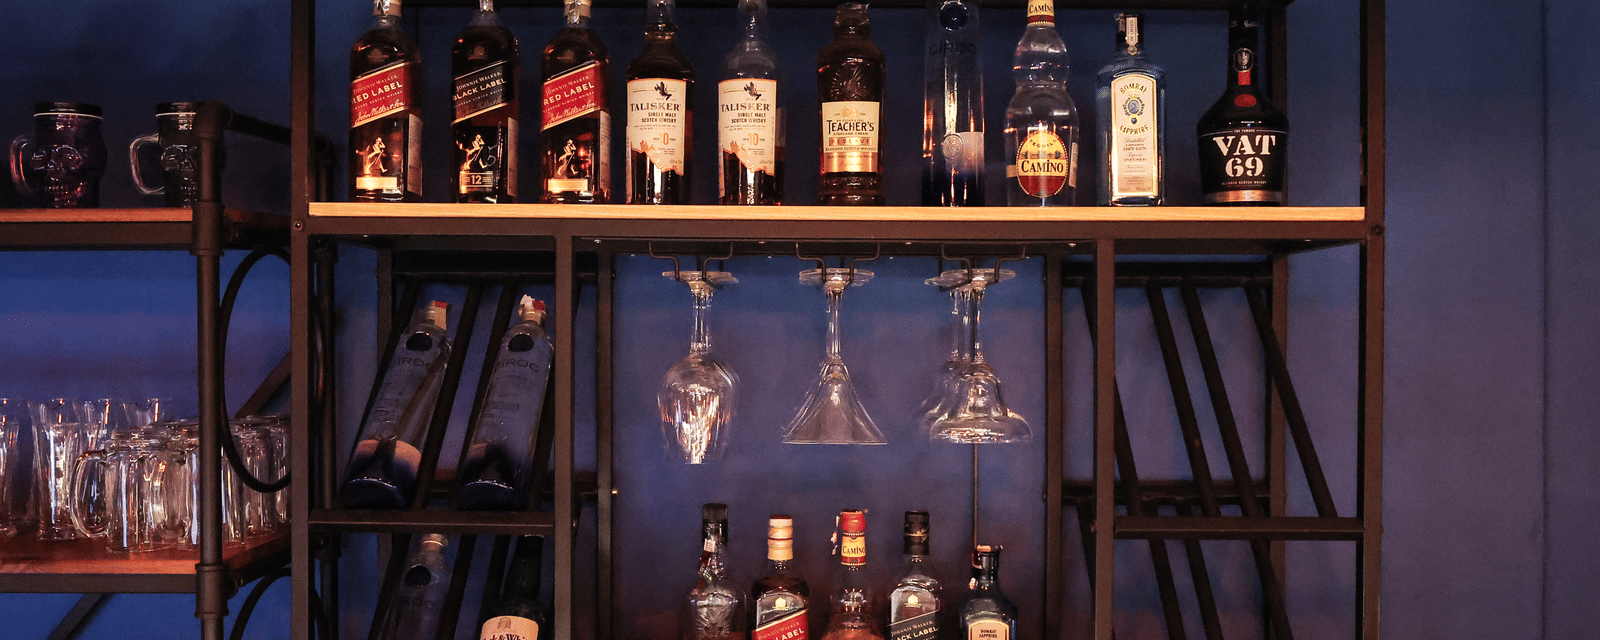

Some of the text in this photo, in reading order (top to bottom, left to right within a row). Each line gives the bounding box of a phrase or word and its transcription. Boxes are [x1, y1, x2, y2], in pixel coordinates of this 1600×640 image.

[351, 92, 370, 104] RED
[371, 80, 403, 97] LABEL
[452, 87, 479, 102] BLACK
[479, 77, 507, 91] LABEL
[543, 94, 562, 106] RED
[563, 81, 595, 98] LABEL
[1119, 82, 1148, 95] BOMBAY
[630, 102, 681, 112] TALISKER
[720, 102, 771, 113] TALISKER
[826, 119, 875, 135] TEACHER'S
[1120, 123, 1150, 135] SAPPHIRE
[747, 132, 759, 146] 10
[1212, 134, 1277, 157] VAT
[1021, 159, 1064, 173] CAMINO
[1225, 157, 1264, 178] 69
[470, 174, 482, 185] 12
[913, 626, 938, 638] LABEL
